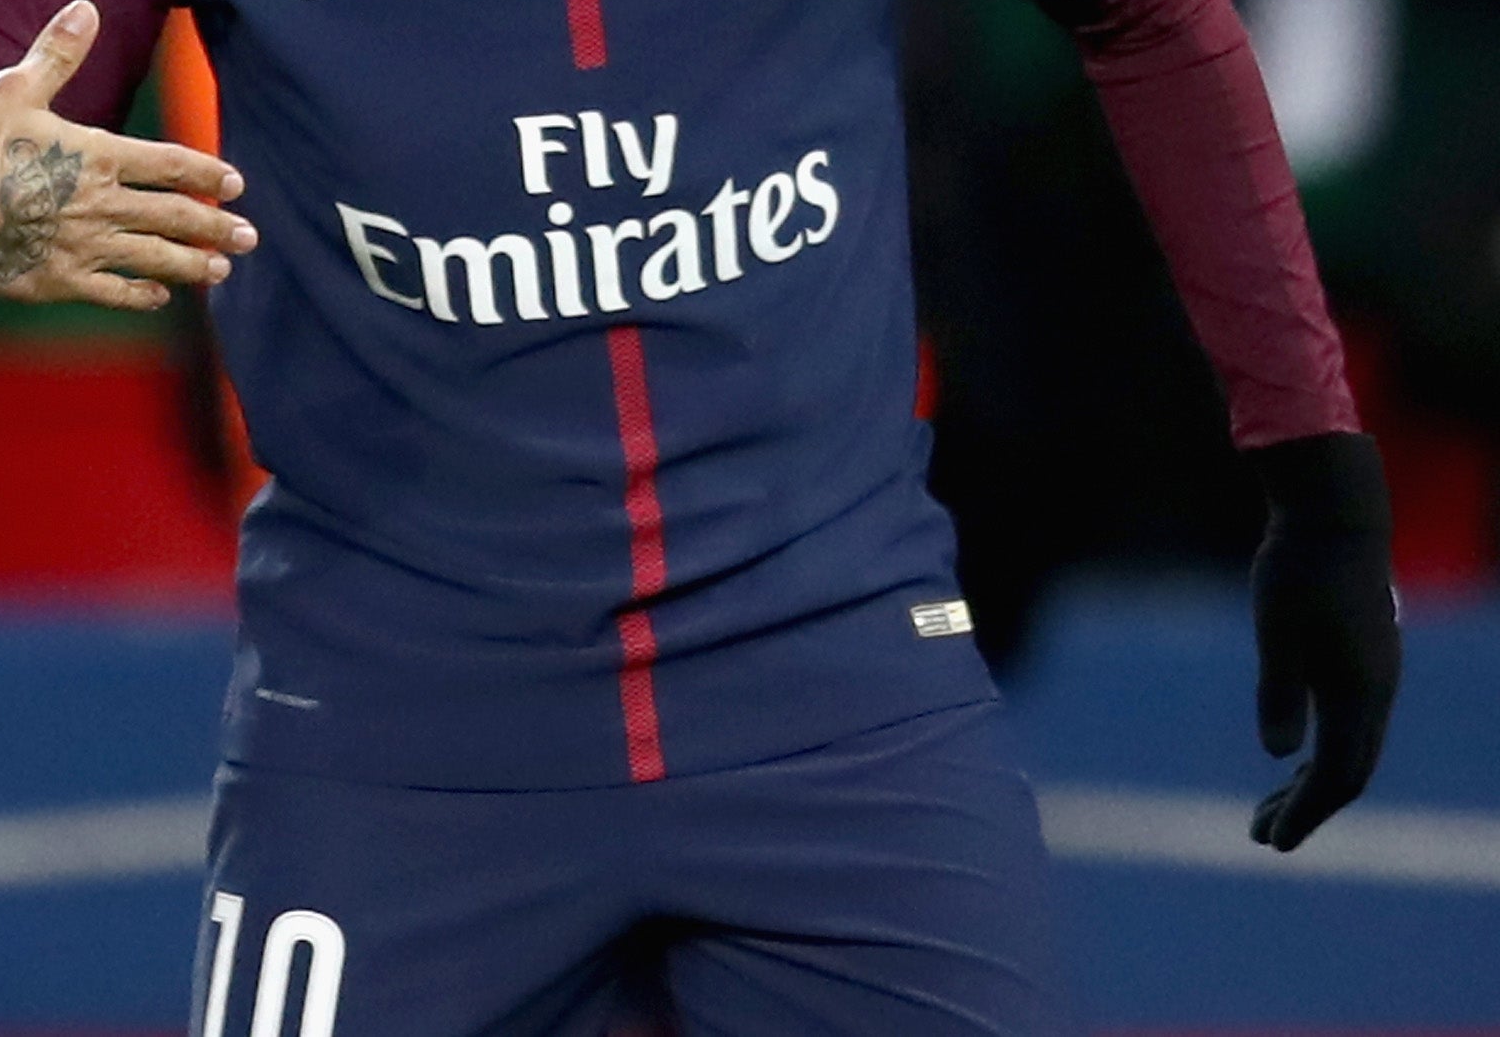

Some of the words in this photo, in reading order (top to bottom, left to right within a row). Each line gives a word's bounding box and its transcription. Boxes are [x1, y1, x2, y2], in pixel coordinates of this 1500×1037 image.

[513, 110, 678, 197] Fly
[335, 149, 840, 325] Emirates
[203, 891, 346, 1037] 10
